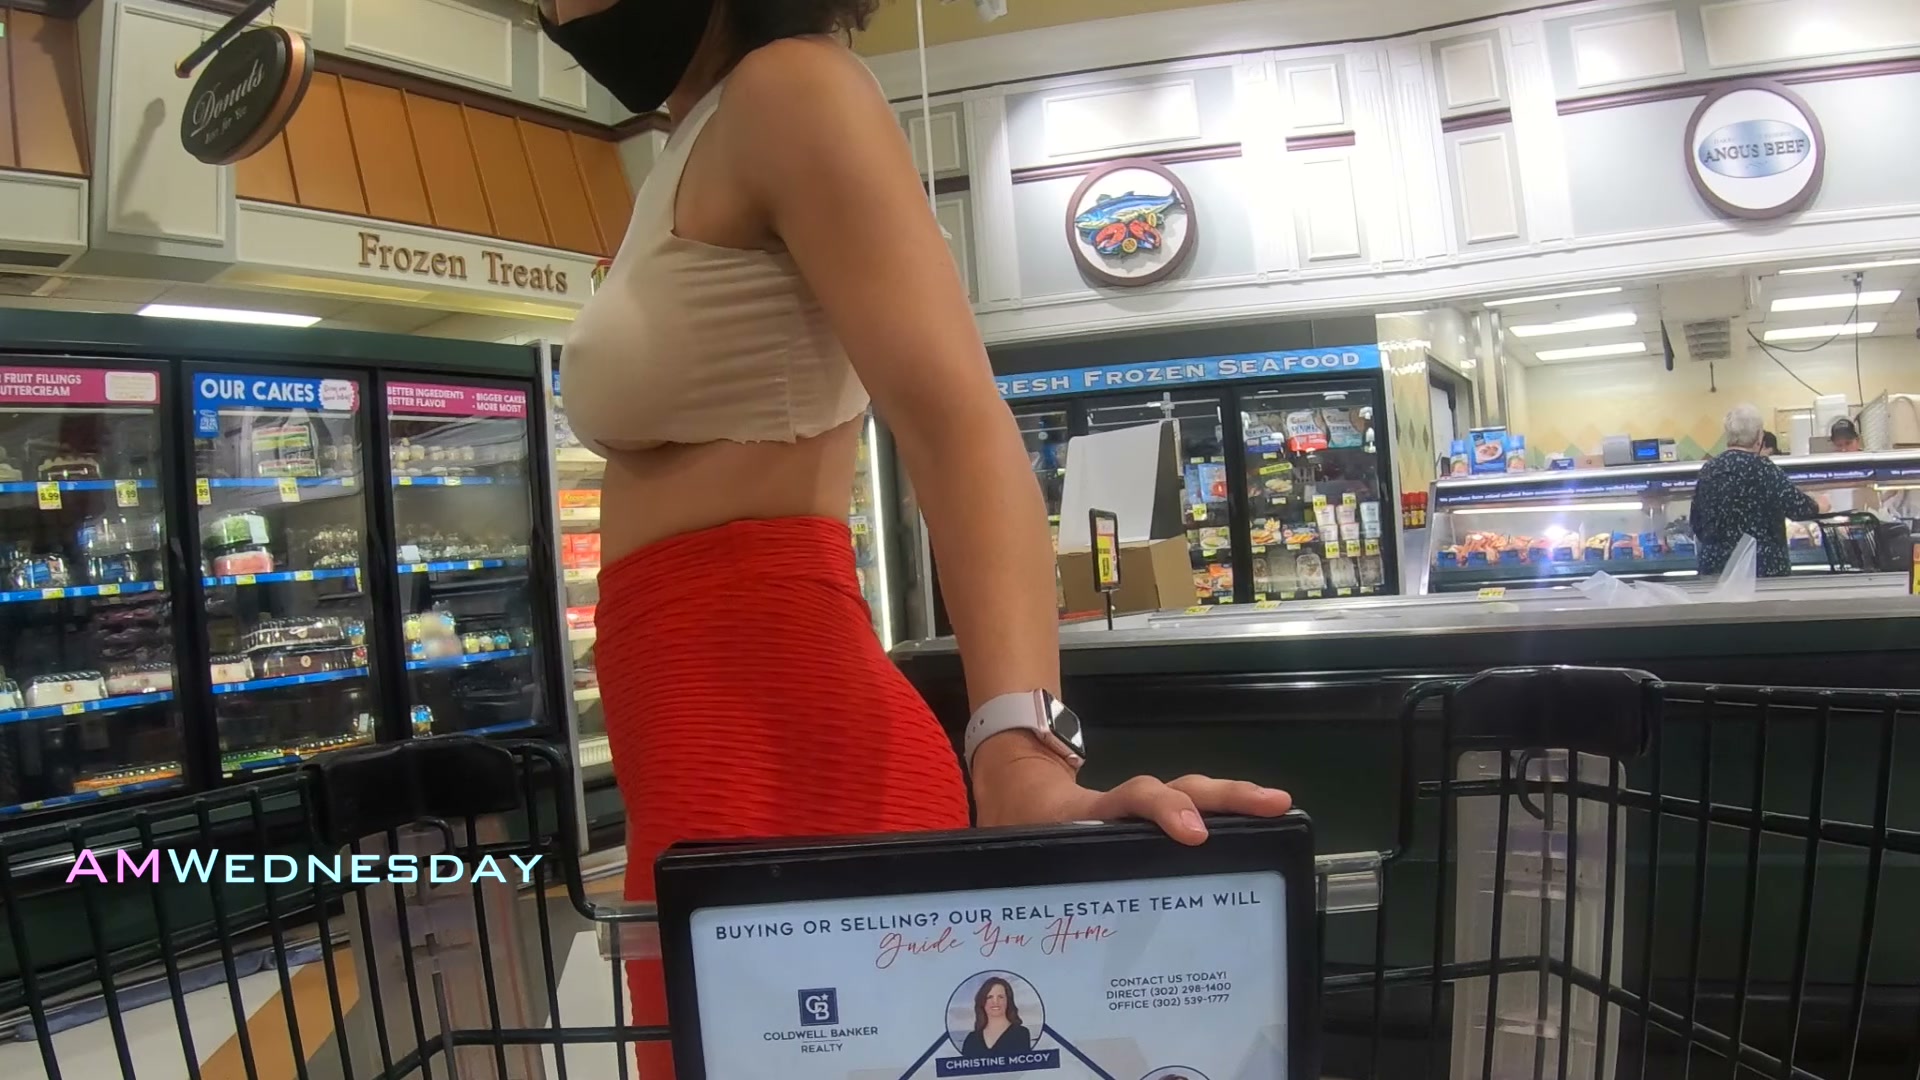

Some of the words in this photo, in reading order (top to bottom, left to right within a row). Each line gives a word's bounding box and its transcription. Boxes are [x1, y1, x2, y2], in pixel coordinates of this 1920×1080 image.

[191, 59, 264, 137] Donuts
[1704, 143, 1760, 164] ANGUS
[1764, 139, 1805, 156] BEEF
[358, 231, 467, 279] Frozen
[482, 250, 568, 293] Treats
[4, 373, 33, 384] FRUIT
[36, 374, 82, 384] FILLINGS
[1084, 363, 1206, 388] FROZEN
[1218, 352, 1360, 376] SEAFOOD
[201, 378, 245, 400] OUR
[252, 381, 315, 403] CAKES
[387, 386, 414, 396] BETTER
[415, 388, 464, 399] INGREDIENTS
[476, 393, 502, 402] BIGGER
[504, 395, 526, 404] CAKES
[387, 397, 414, 406] BETTER
[416, 398, 446, 408] FLAVOR
[476, 403, 498, 411] MORE
[499, 404, 522, 413] MOIST
[716, 922, 794, 940] BUYING
[803, 919, 831, 935] OR
[841, 912, 939, 932] SELLING?
[949, 909, 992, 925] OUR
[1002, 904, 1055, 921] REAL
[1064, 898, 1140, 917] ESTATE
[1149, 895, 1204, 912] TEAM
[1213, 890, 1261, 906] WILL
[875, 926, 965, 970] Guide
[973, 919, 1033, 958] You
[1041, 916, 1118, 955] Home
[1110, 975, 1164, 987] CONTACT
[1168, 974, 1183, 983] US
[1186, 971, 1227, 982] TODAY!
[1106, 988, 1147, 999] DIRECT
[1150, 985, 1179, 997] (302)
[1182, 982, 1232, 994] 298-1400
[1109, 1000, 1150, 1011] OFFICE
[1153, 996, 1181, 1008] (302)
[1184, 993, 1230, 1005] 539-1777
[763, 1029, 828, 1041] COLDWELL
[830, 1026, 879, 1038] BANKER
[801, 1043, 844, 1054] REALTY
[946, 1056, 1006, 1070] CHRISTINE
[1009, 1052, 1051, 1065] MCCOY
